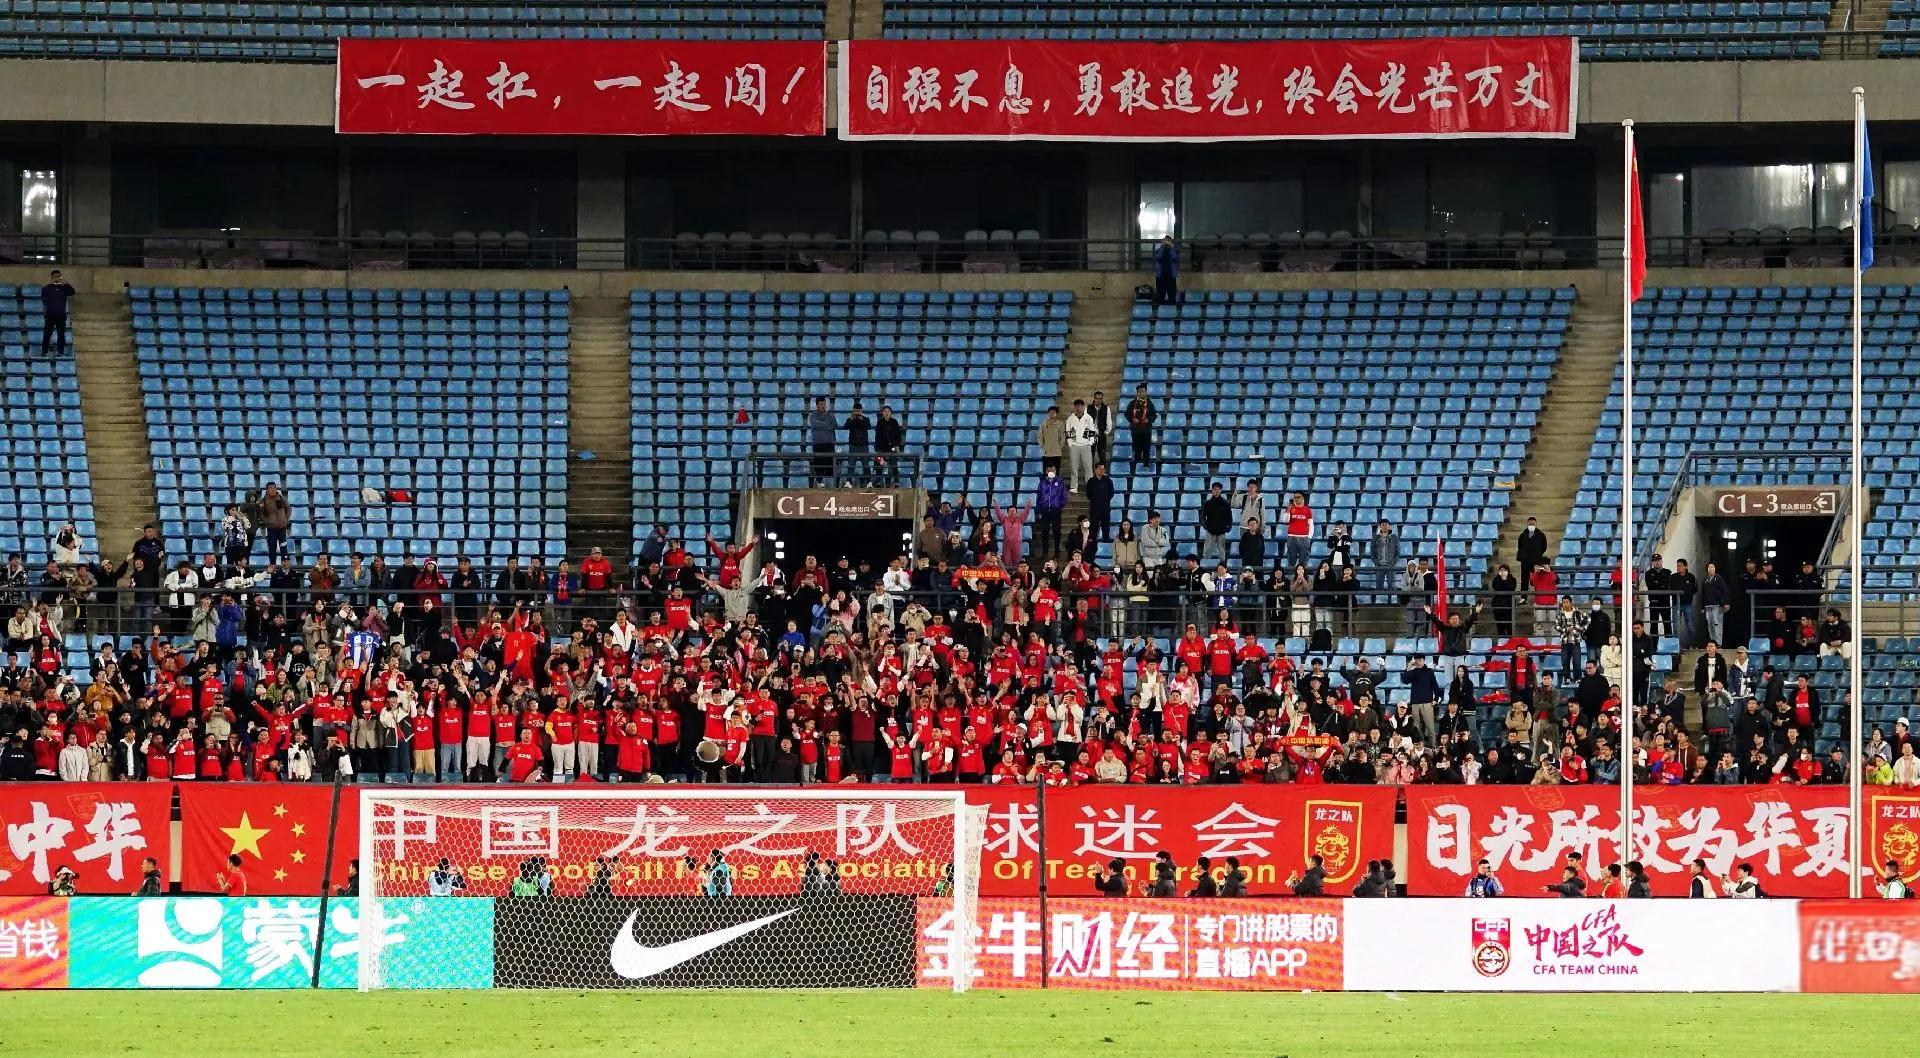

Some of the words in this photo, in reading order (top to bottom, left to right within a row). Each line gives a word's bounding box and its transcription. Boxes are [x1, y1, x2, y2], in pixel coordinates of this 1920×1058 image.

[777, 496, 837, 516] C1-4
[1718, 493, 1779, 514] C1-3
[1315, 808, 1353, 822] 龙之队
[0, 801, 148, 884] 中华
[993, 859, 1034, 880] Of
[1582, 903, 1616, 931] CFA
[1195, 913, 1338, 943] 专门讲股票的
[1533, 964, 1556, 975] CFA
[1560, 964, 1595, 975] TEAM
[1598, 964, 1639, 975] CHINA
